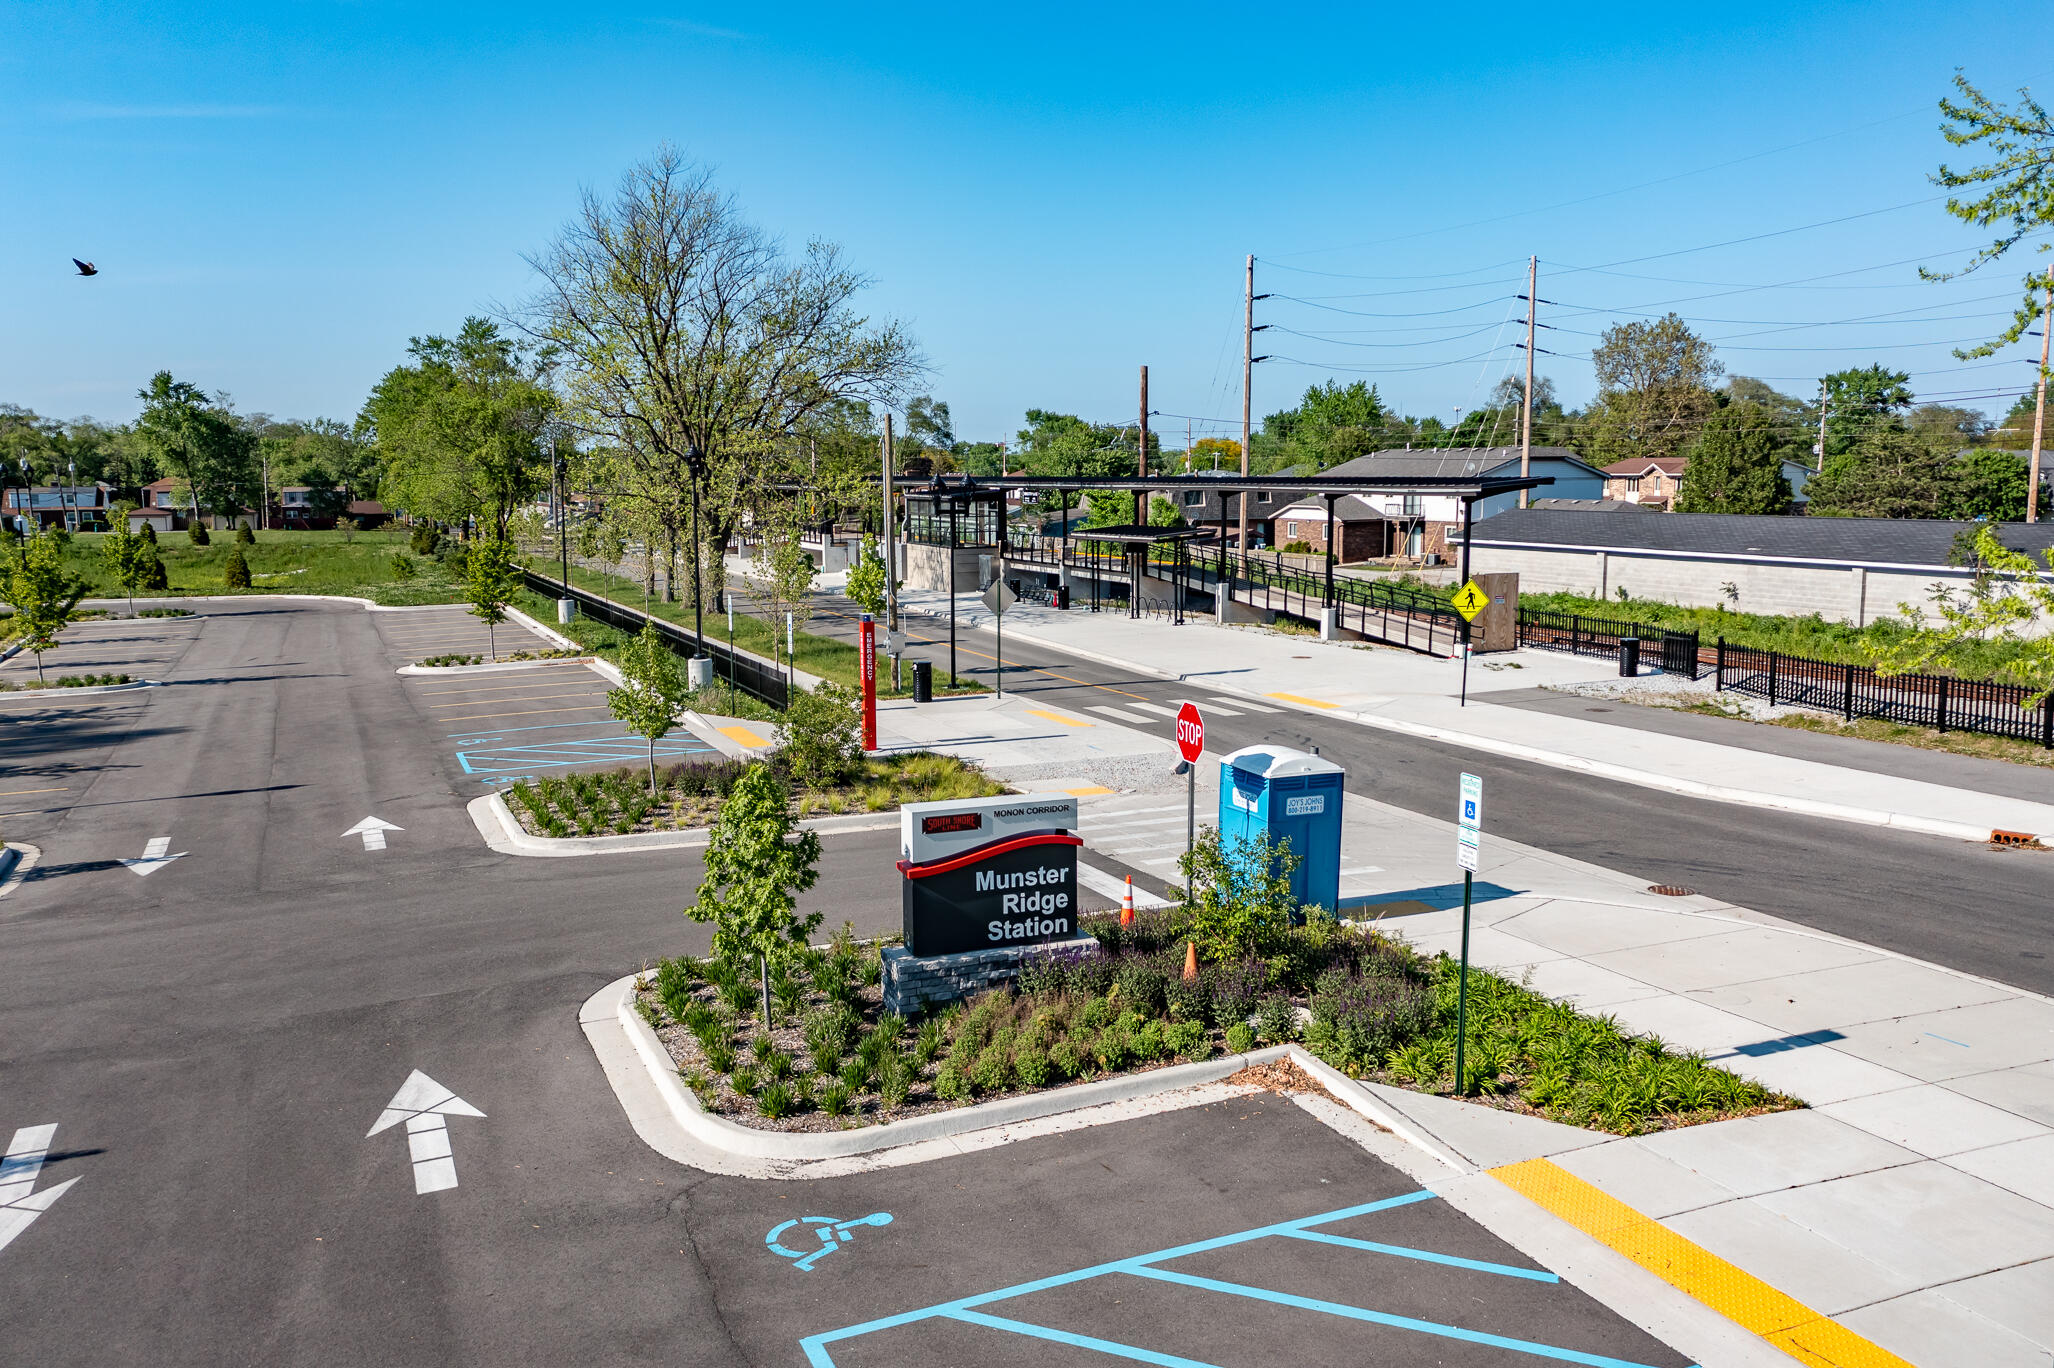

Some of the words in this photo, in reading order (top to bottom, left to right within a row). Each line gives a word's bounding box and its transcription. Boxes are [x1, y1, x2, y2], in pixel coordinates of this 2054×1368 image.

[1178, 719, 1202, 746] STOP
[993, 808, 1024, 818] MONON
[1027, 804, 1070, 815] CORRIDOR
[1288, 798, 1304, 807] JOY'S
[1305, 797, 1323, 805] JOHNS
[976, 866, 1069, 892] Munster
[1002, 891, 1069, 914] Ridge
[988, 917, 1068, 941] Station
